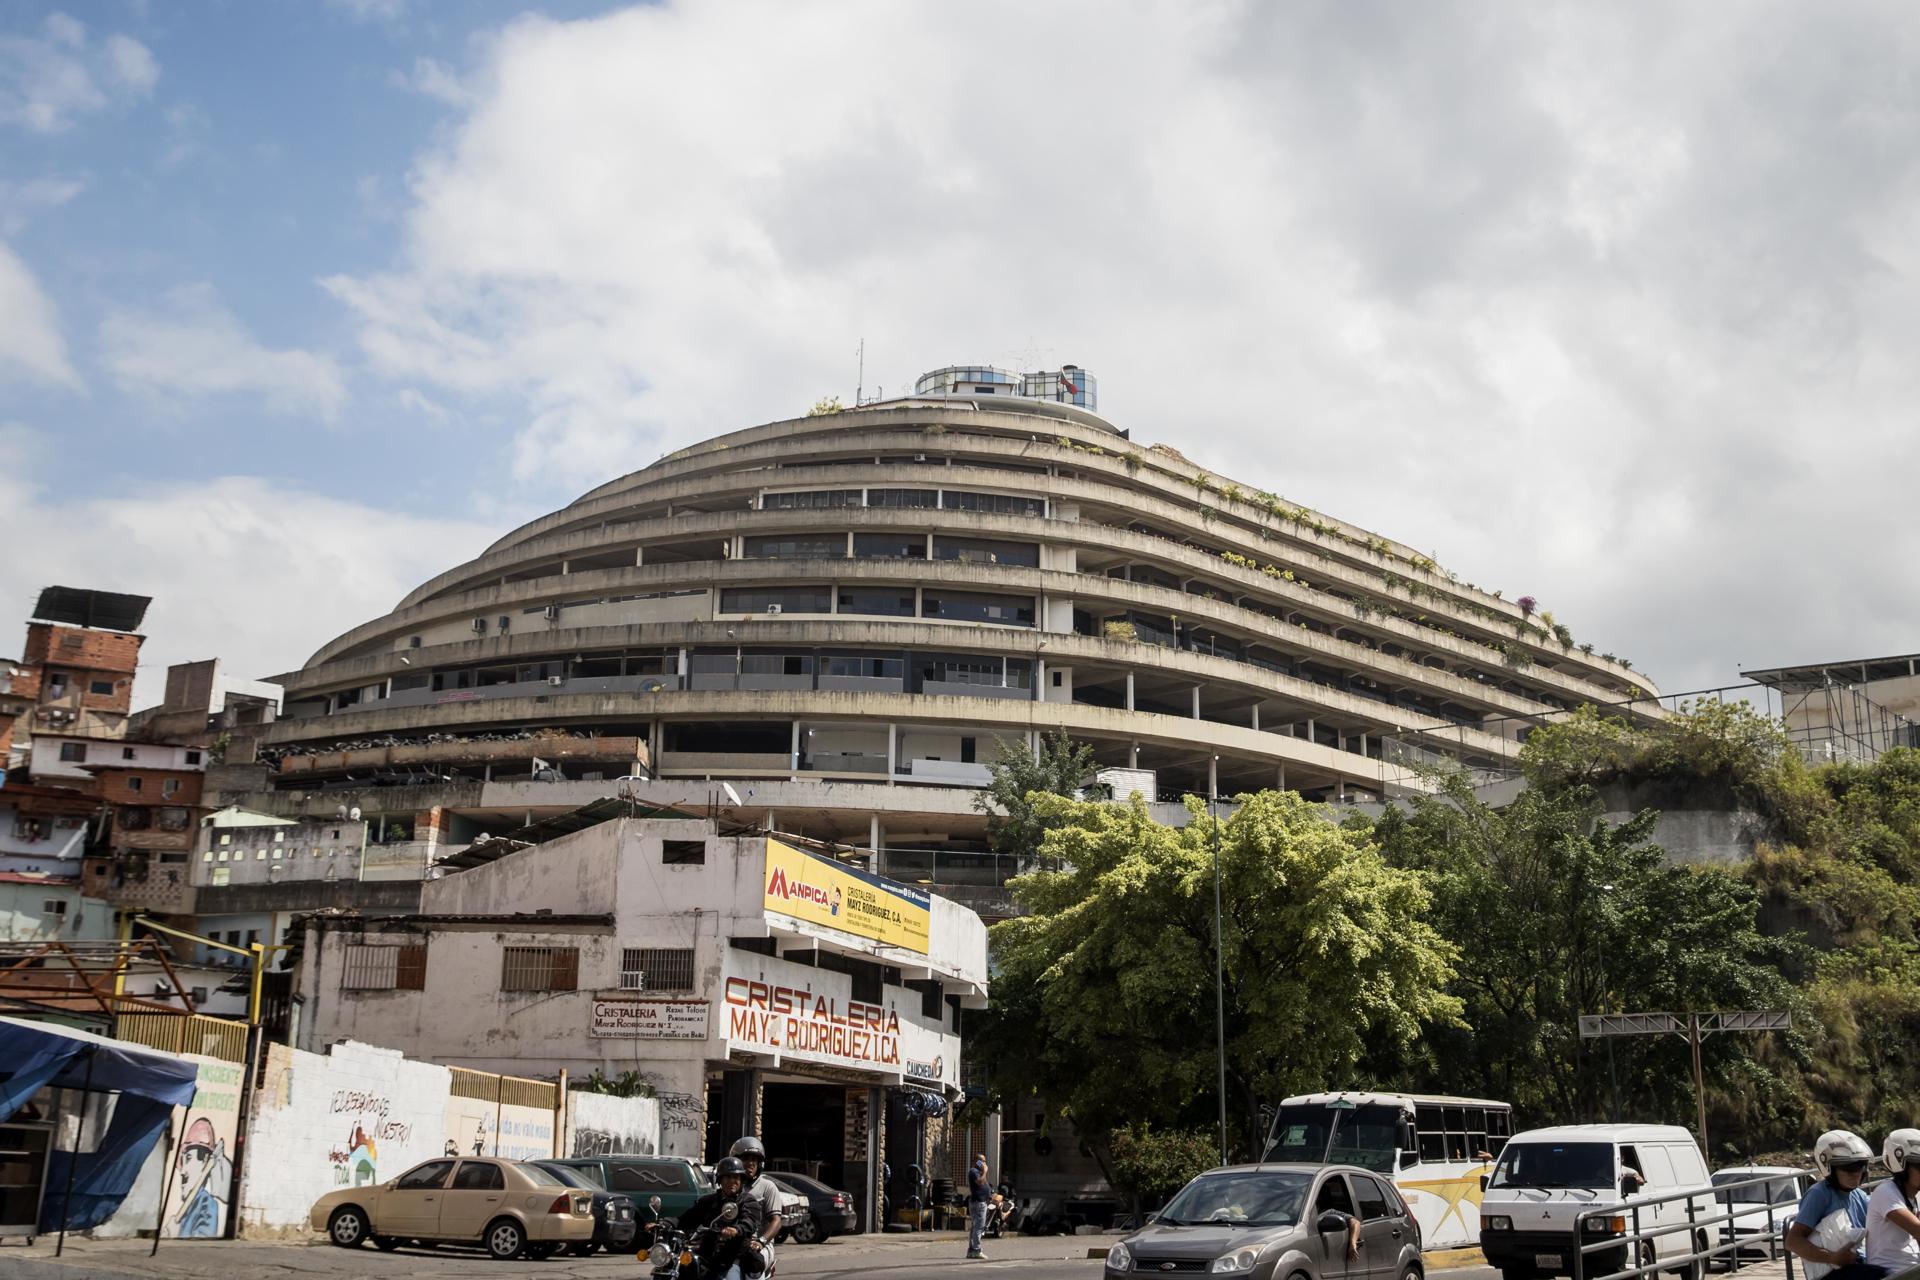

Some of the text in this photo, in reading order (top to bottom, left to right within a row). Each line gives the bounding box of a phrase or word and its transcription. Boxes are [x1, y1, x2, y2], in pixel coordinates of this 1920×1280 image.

[767, 867, 829, 906] MANPICA
[847, 897, 861, 912] MAYZ
[595, 1003, 657, 1018] CRISTALERIA
[616, 1018, 656, 1029] RODRIGUEZ
[787, 1017, 871, 1061] RODRIGUEZ
